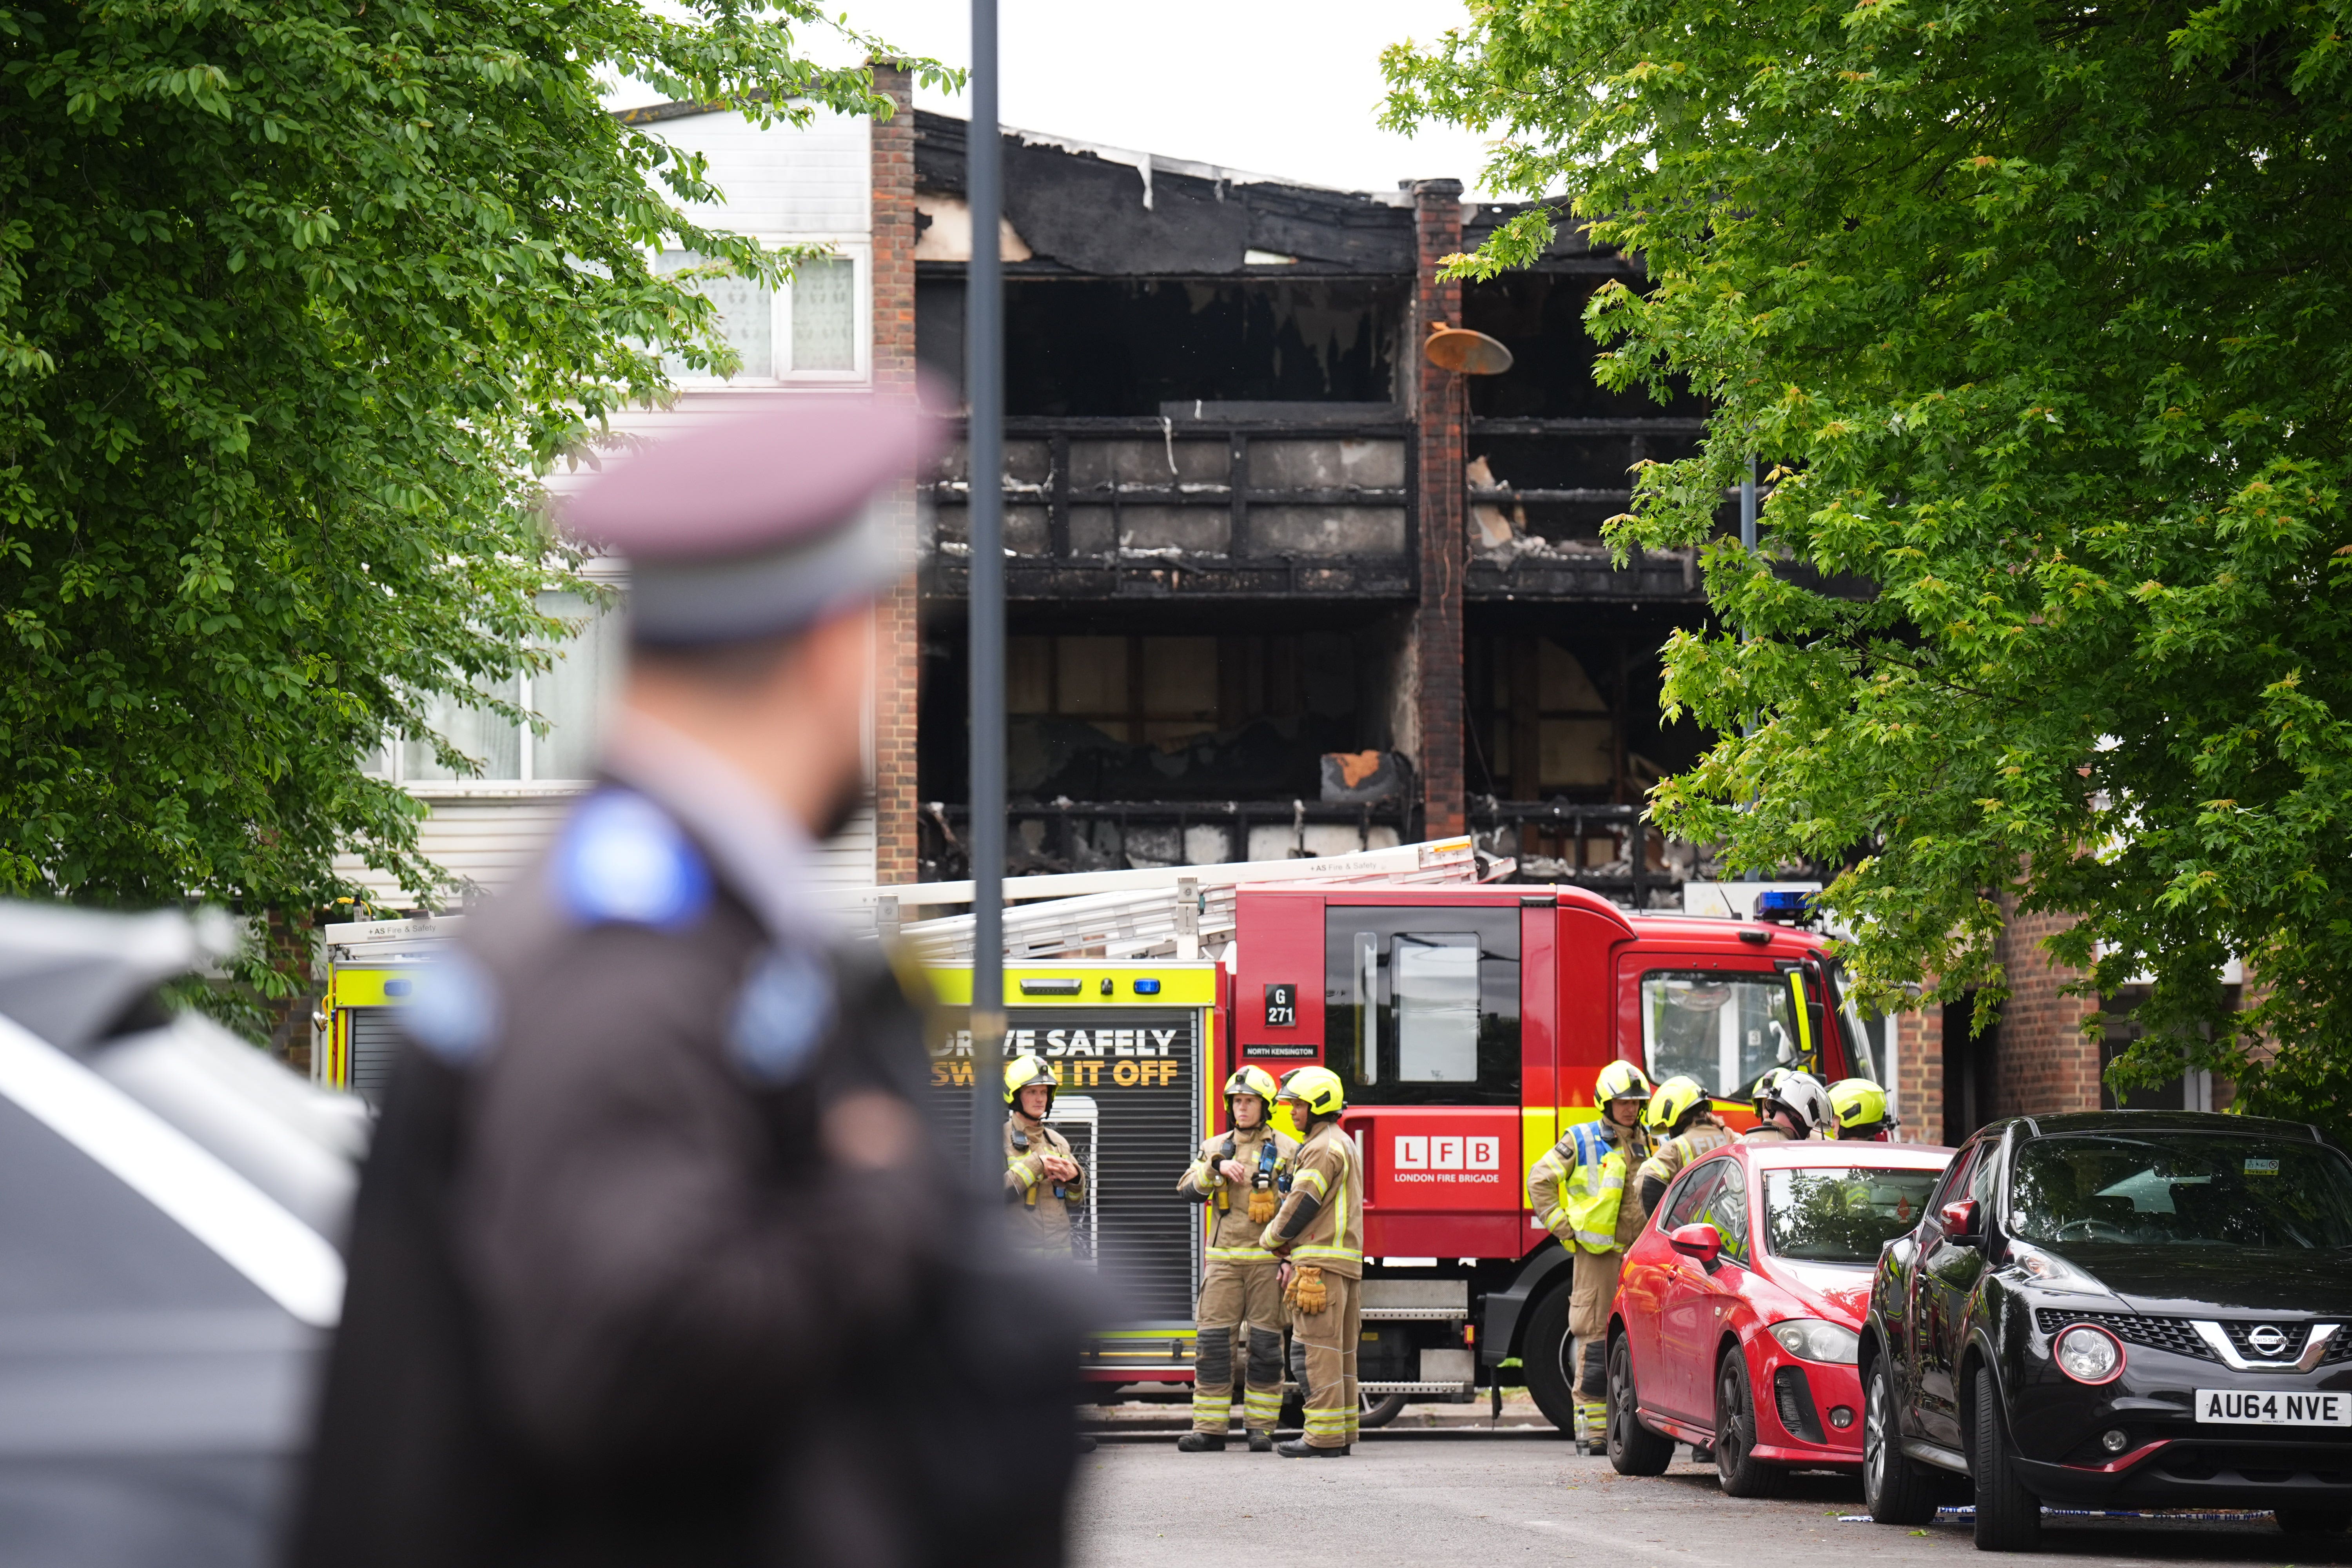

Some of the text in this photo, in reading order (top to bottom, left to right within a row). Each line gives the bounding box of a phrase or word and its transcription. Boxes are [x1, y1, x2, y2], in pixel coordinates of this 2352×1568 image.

[1275, 989, 1286, 1004] G
[1268, 1007, 1293, 1022] 271
[1046, 1029, 1176, 1056] SAFELY
[1074, 1060, 1105, 1086] IT
[1112, 1060, 1178, 1086] OFF
[1394, 1174, 1499, 1183] LONDON FIRE BRIGADE
[2208, 1394, 2338, 1421] AU64 NVE
